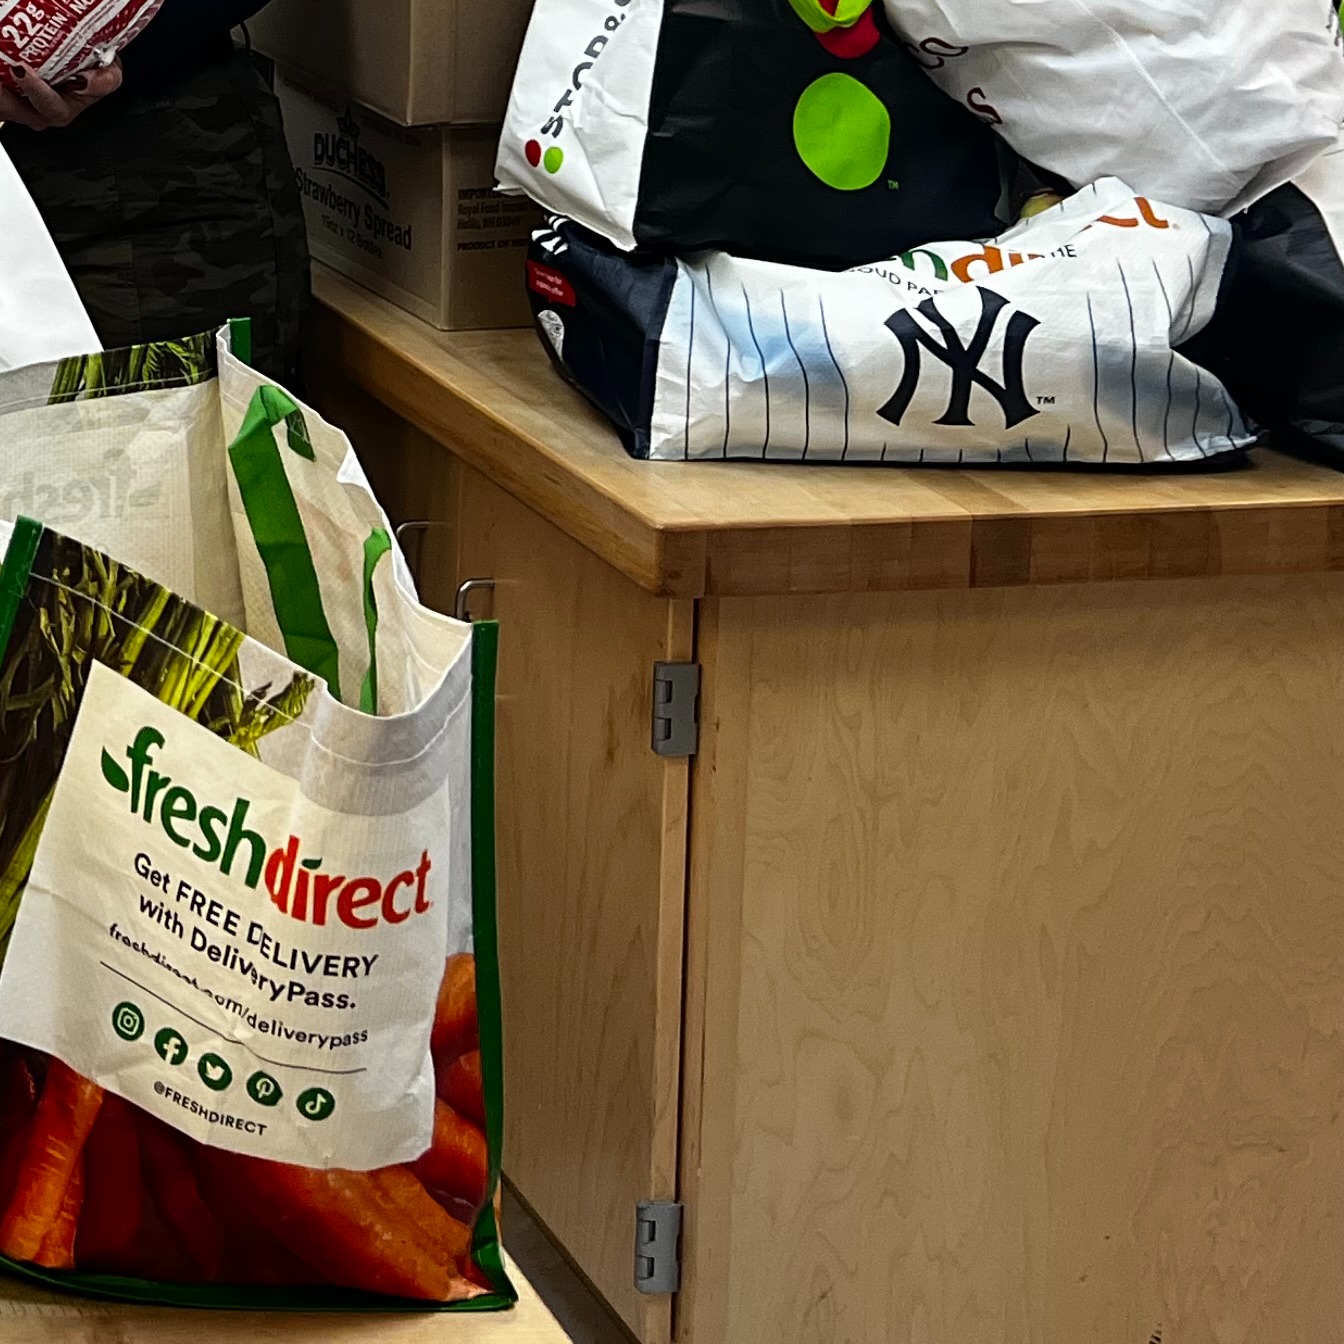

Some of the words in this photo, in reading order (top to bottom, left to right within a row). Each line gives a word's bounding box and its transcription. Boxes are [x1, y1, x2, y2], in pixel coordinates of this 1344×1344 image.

[0, 0, 51, 52] 22g
[17, 10, 70, 65] PROTEIN
[313, 132, 387, 197] DUCHESS
[296, 167, 362, 229] Strawberry
[363, 205, 412, 252] Spread
[101, 726, 433, 930] freshdirect
[133, 852, 170, 895] Get
[176, 882, 240, 938] FREE
[246, 921, 380, 979] DELIVERY
[139, 895, 185, 942] with
[190, 925, 357, 1010] DeliveryPass.
[153, 1079, 268, 1137] @FRESHDIRECT
